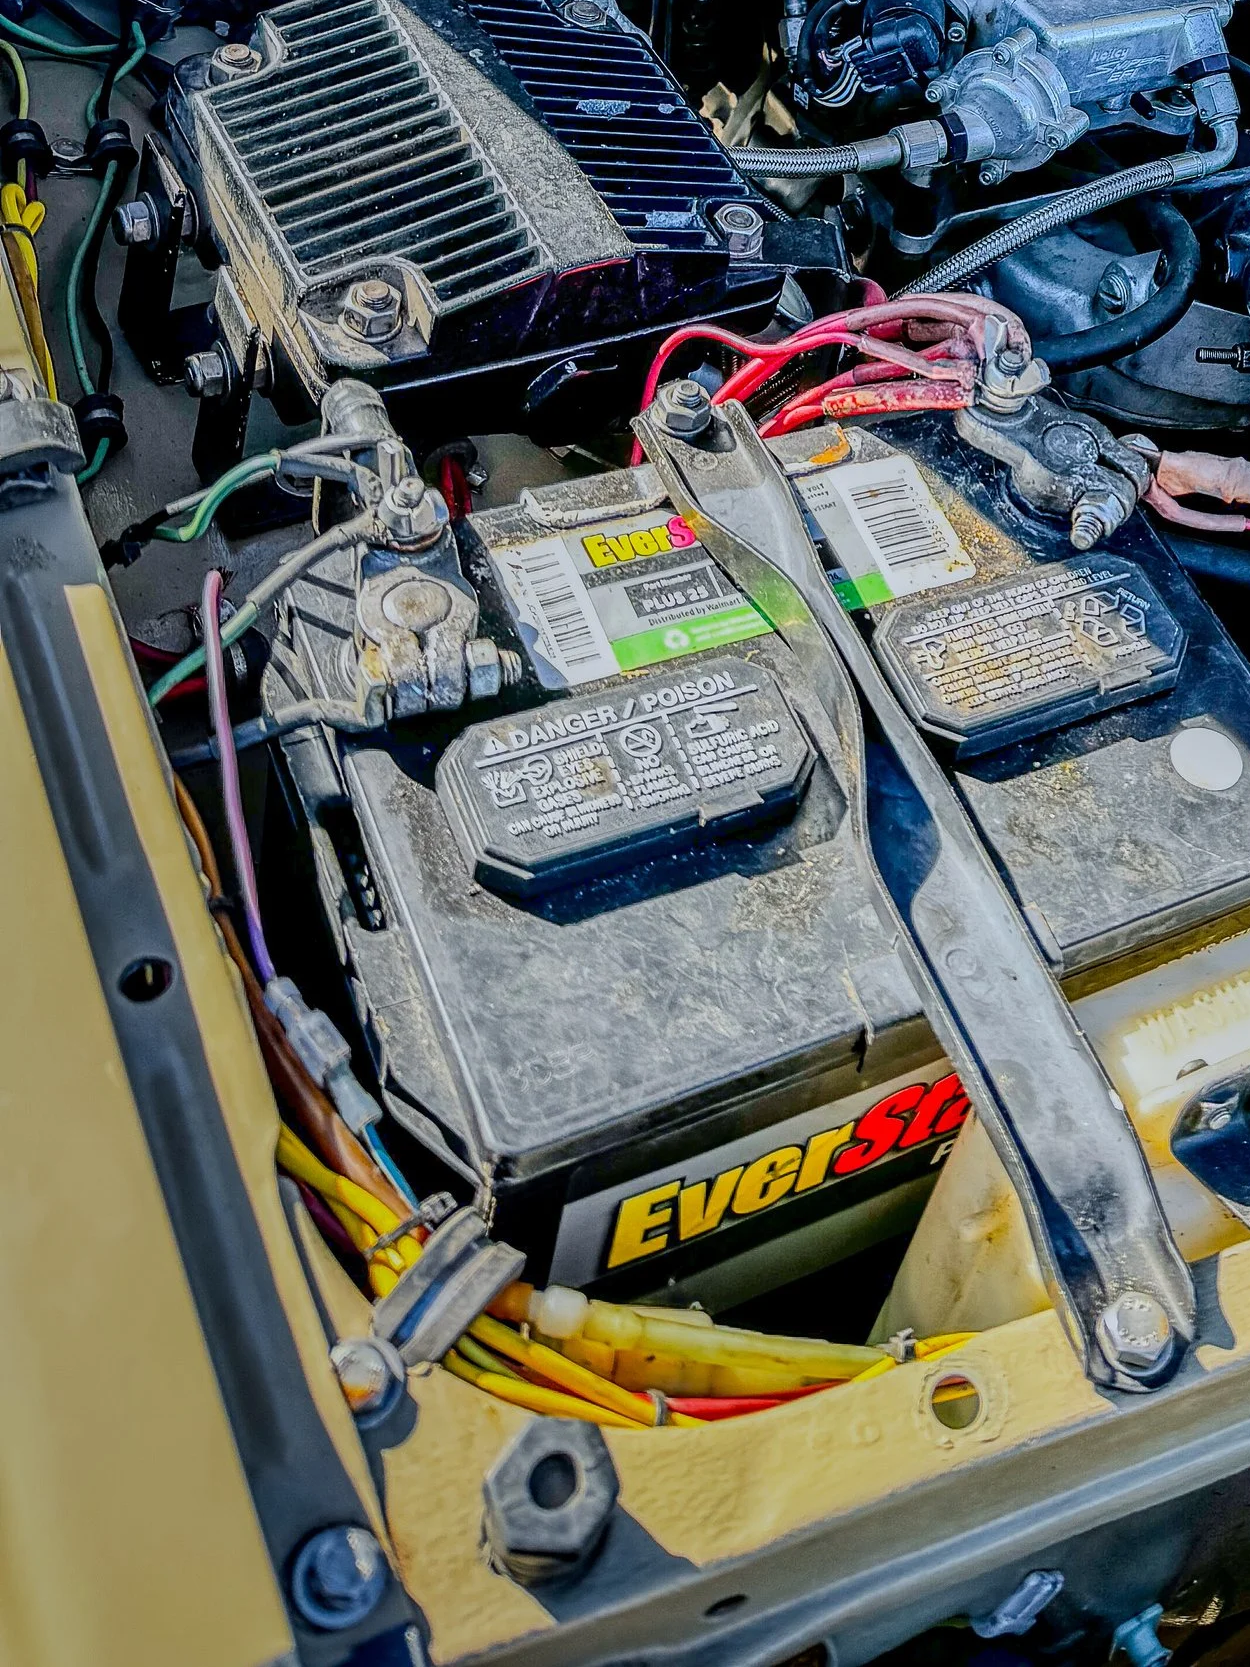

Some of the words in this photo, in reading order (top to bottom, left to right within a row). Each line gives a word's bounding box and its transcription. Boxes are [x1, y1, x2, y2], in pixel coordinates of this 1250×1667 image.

[643, 591, 685, 611] PLUS
[649, 609, 693, 625] Distributed
[696, 606, 706, 615] by
[706, 597, 740, 611] Walmart
[511, 705, 618, 750] DANGER
[642, 671, 735, 712] POISON
[688, 728, 747, 754] SULFURIC
[749, 720, 778, 737] ACID
[553, 742, 600, 764] SHIELD
[635, 754, 660, 771] NO
[558, 758, 593, 777] EYES
[532, 769, 604, 798] EXPLOSIVE
[538, 790, 581, 812] GASES
